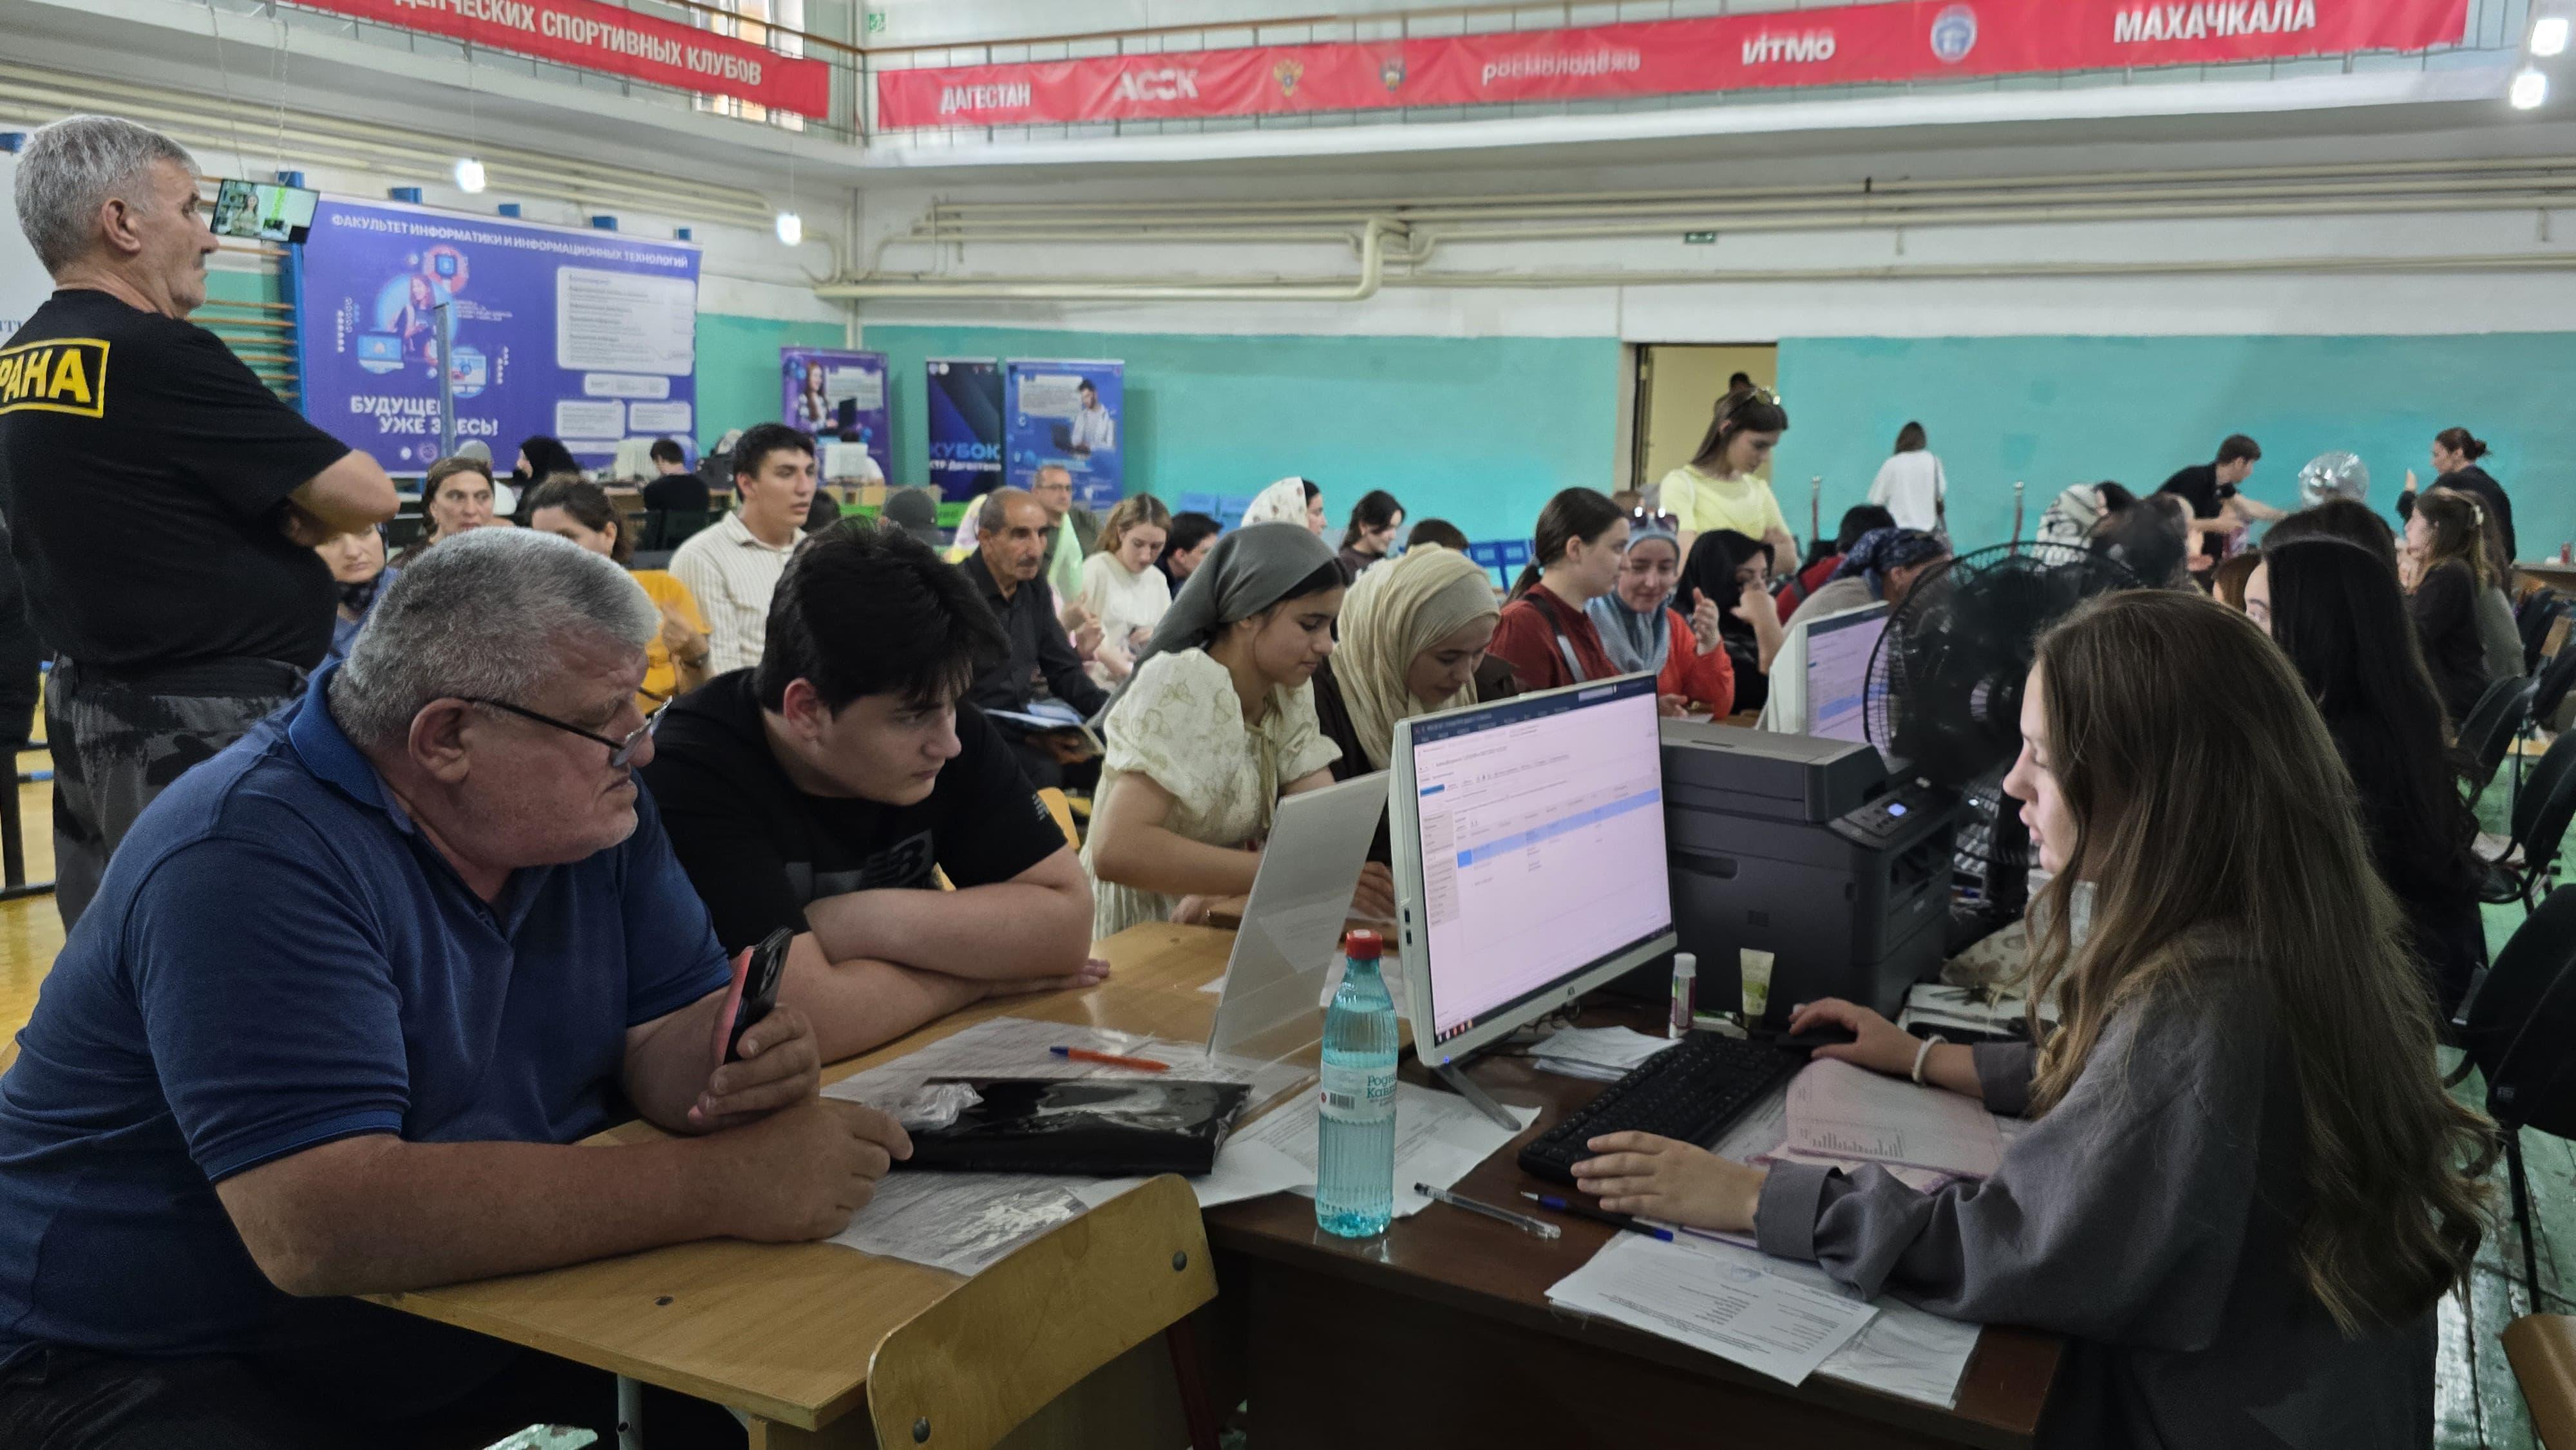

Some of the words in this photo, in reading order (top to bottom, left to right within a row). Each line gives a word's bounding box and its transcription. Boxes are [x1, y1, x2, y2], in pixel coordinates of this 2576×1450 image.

[2113, 0, 2316, 43] МАХАЧКАЛА
[542, 9, 683, 68] СПОРТИВНЫХ
[686, 49, 762, 86] КЛУБОВ
[940, 83, 1031, 115] ДАГЕСТАН
[332, 214, 407, 234] ФАКУЛЬТЕТ
[410, 224, 502, 246] ИНФОРМАТИКИ
[515, 236, 622, 259] ИНФОРМАЦИОННЫХ
[625, 250, 688, 268] ТЕХНОЛОГИЙ
[351, 395, 440, 417] БУДУЩЕ
[380, 417, 426, 434] УЖЕ
[431, 419, 498, 436] ЗЕСЬ!
